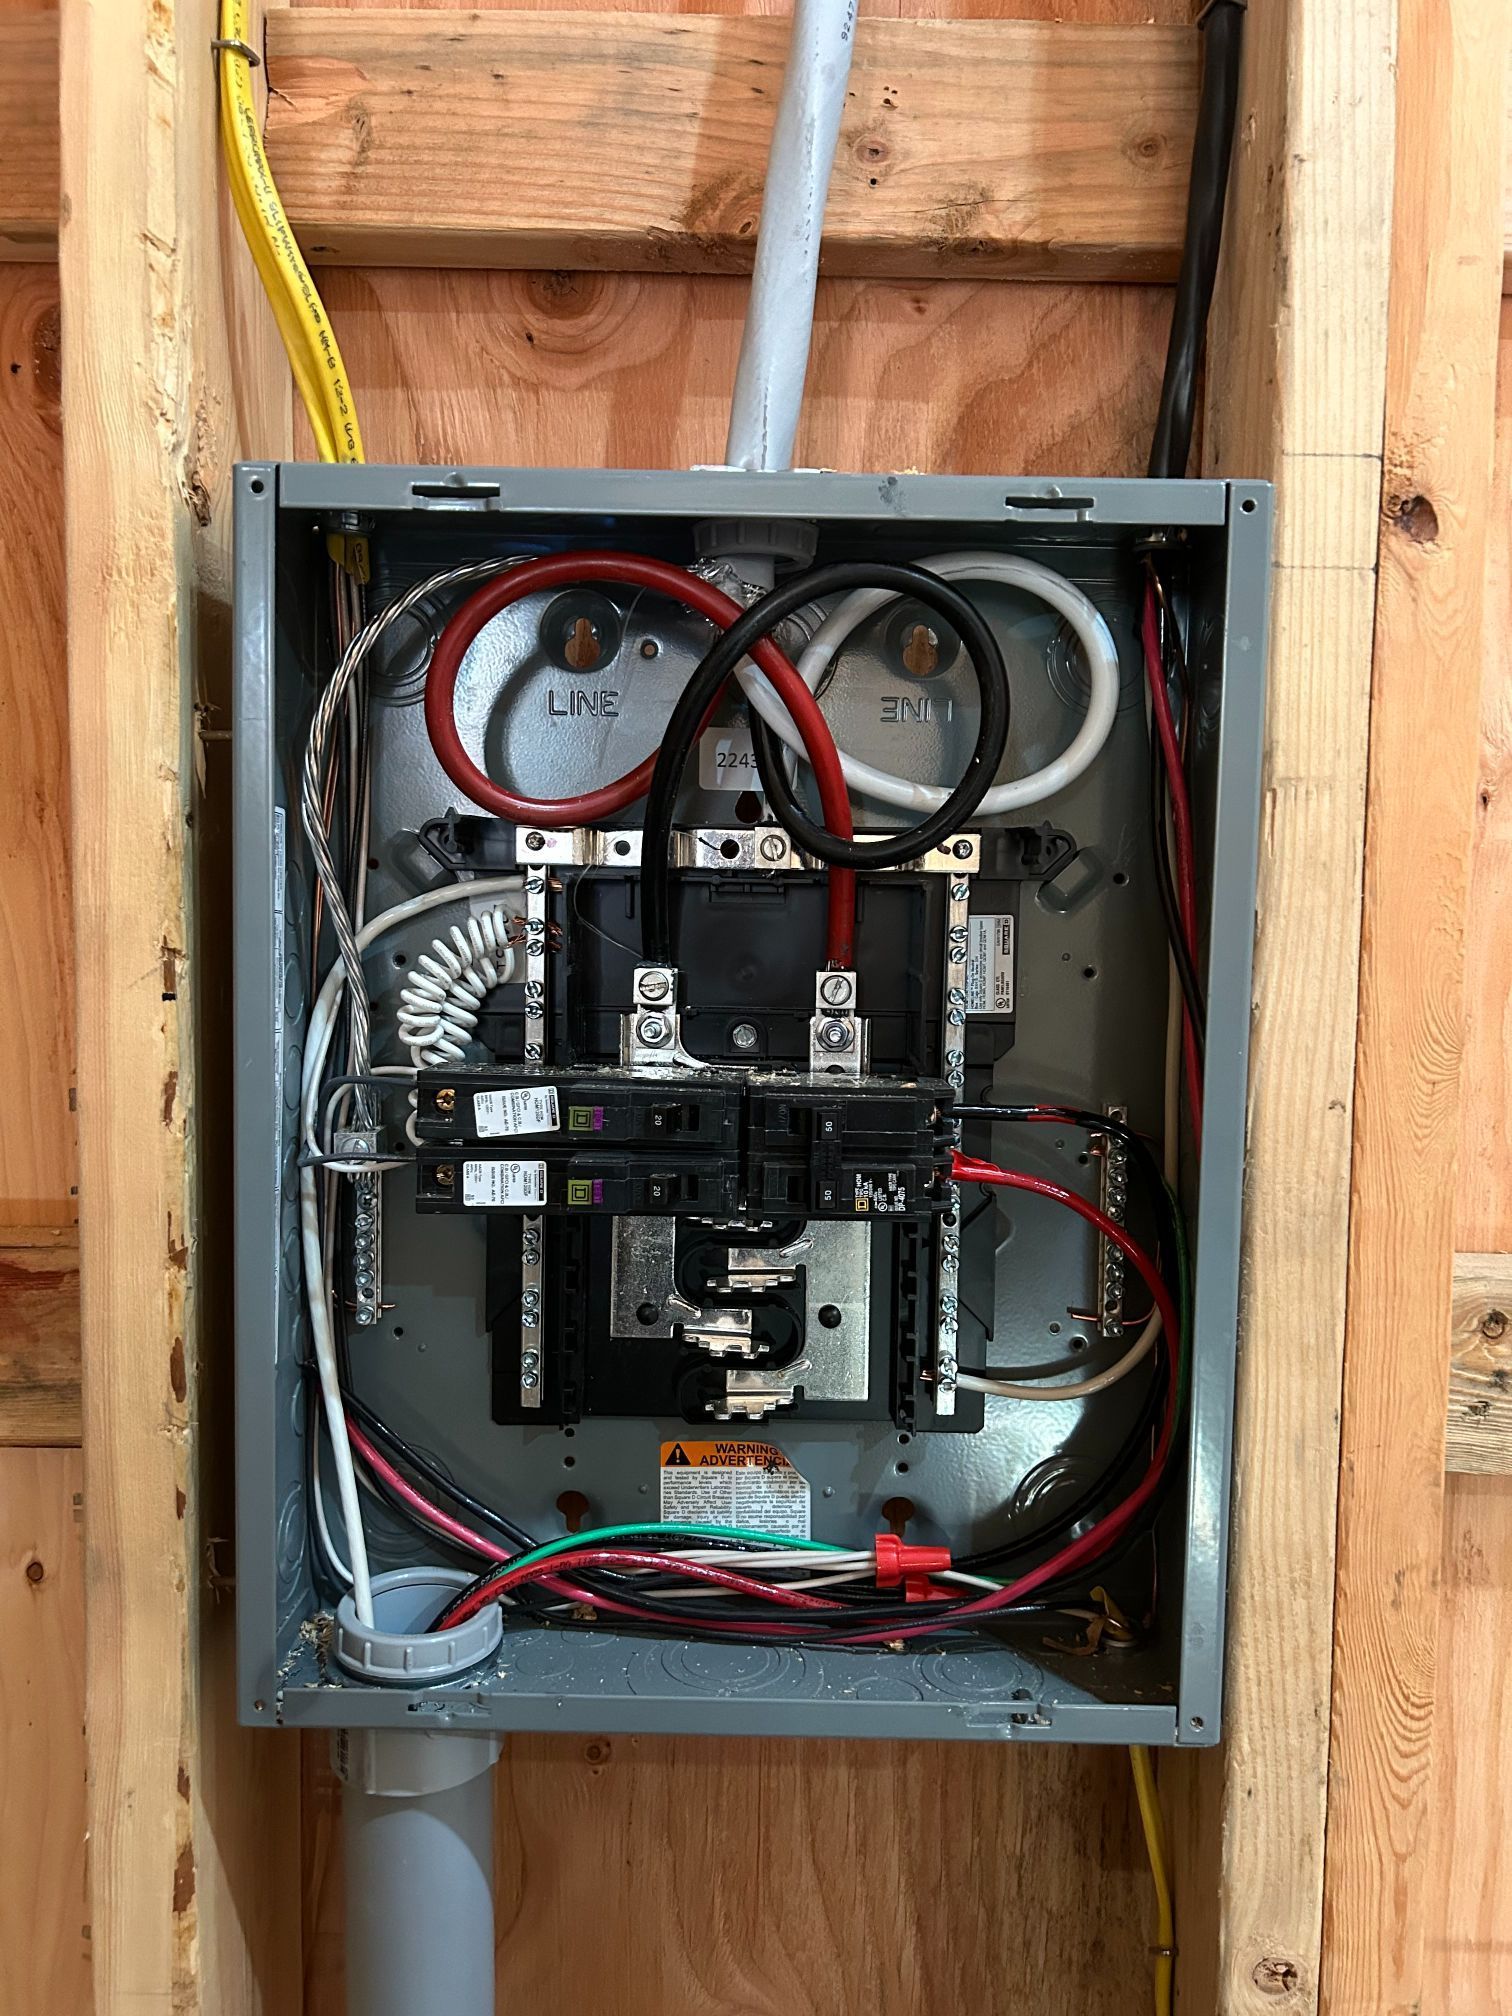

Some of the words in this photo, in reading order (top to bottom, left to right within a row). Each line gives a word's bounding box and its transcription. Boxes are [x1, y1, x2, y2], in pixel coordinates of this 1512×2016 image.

[549, 689, 619, 717] LINE
[654, 1114, 662, 1126] 20
[826, 1121, 833, 1132] 50
[653, 1186, 661, 1197] 20
[824, 1190, 832, 1200] 50
[715, 1443, 779, 1456] WARNING
